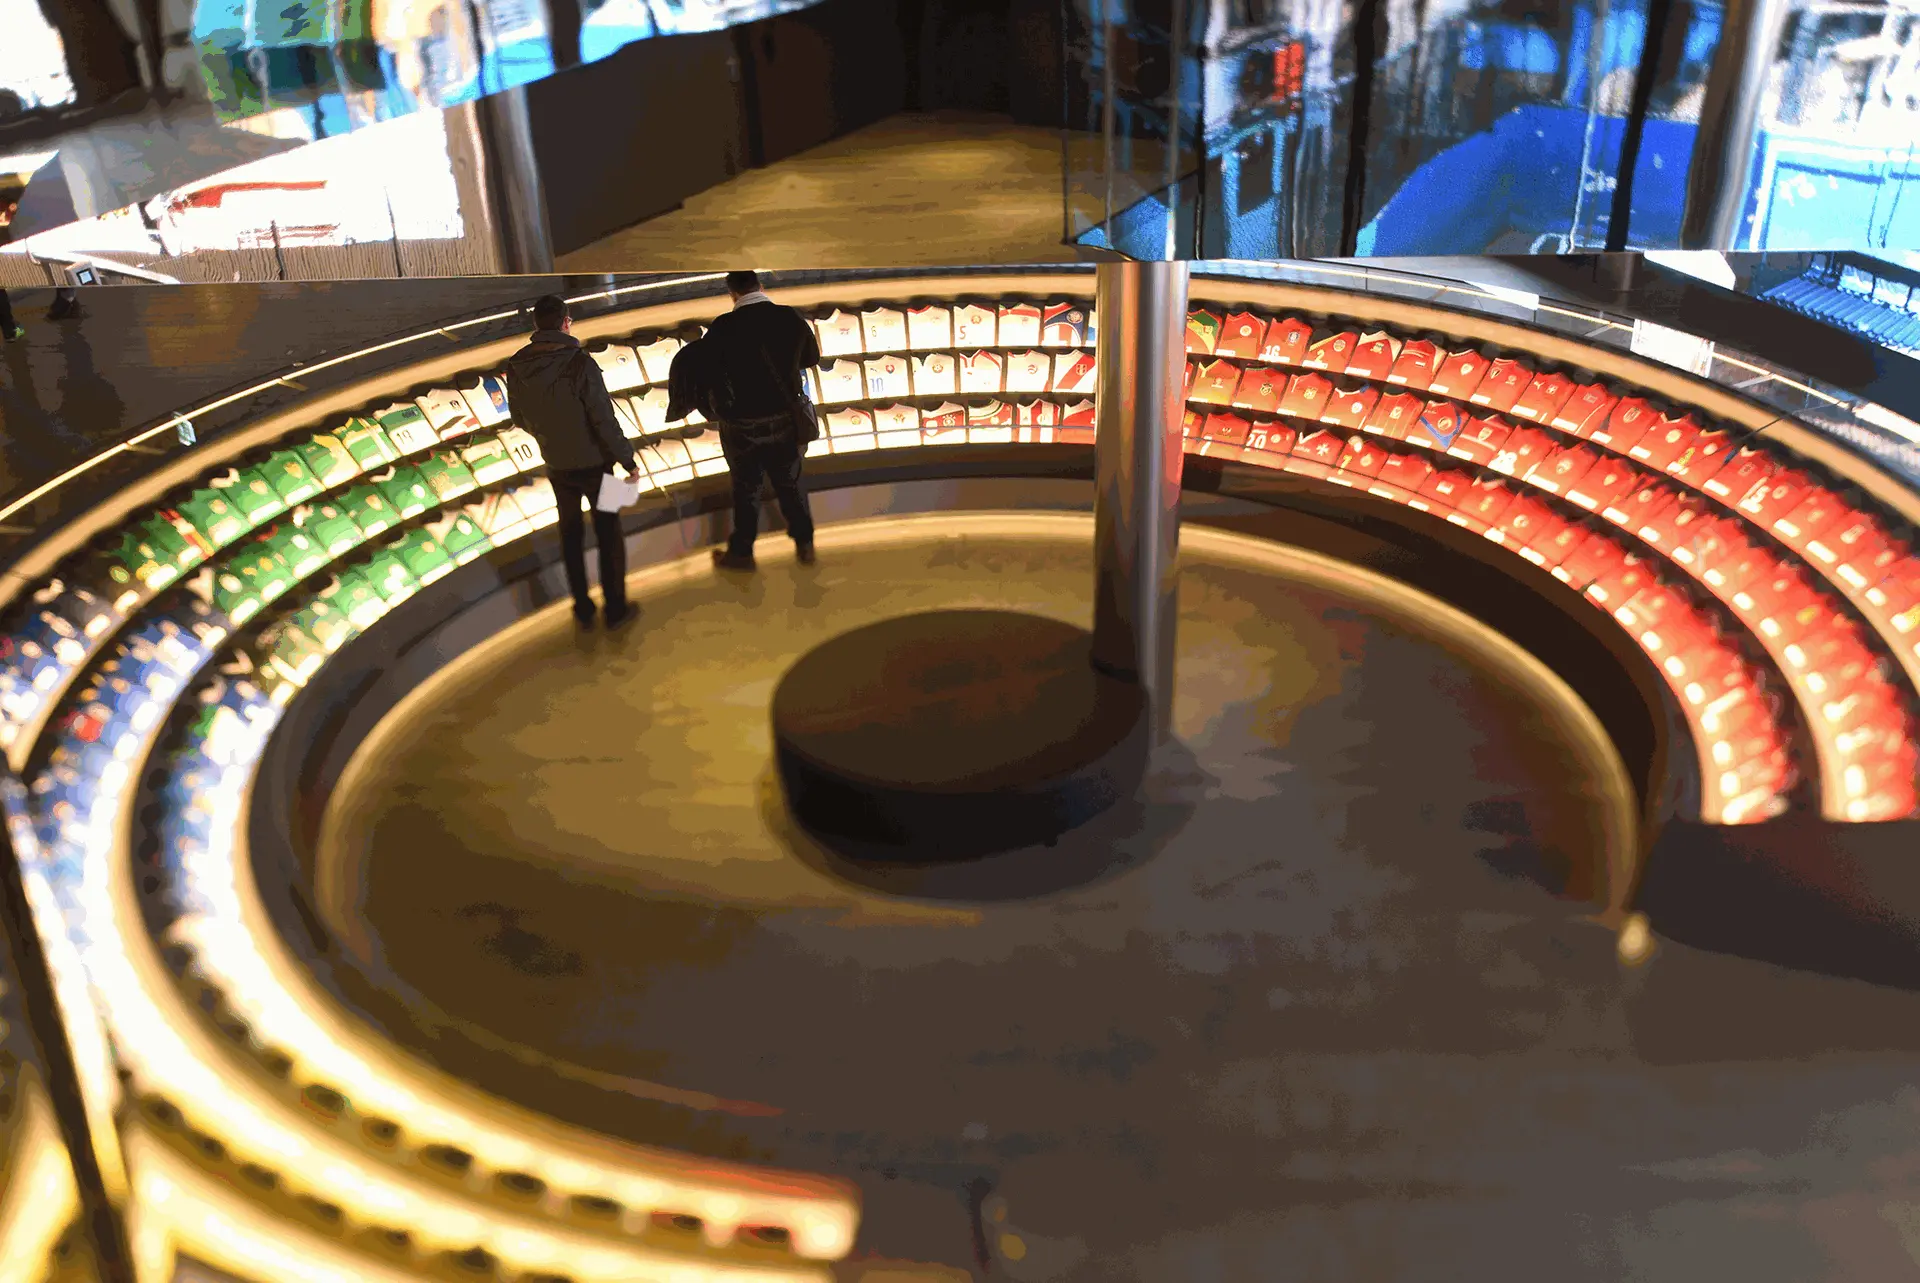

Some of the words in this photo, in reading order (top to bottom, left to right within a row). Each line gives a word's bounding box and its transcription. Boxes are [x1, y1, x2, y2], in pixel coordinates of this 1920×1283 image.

[871, 325, 877, 338] 6
[959, 325, 967, 340] 5
[514, 443, 533, 462] 10
